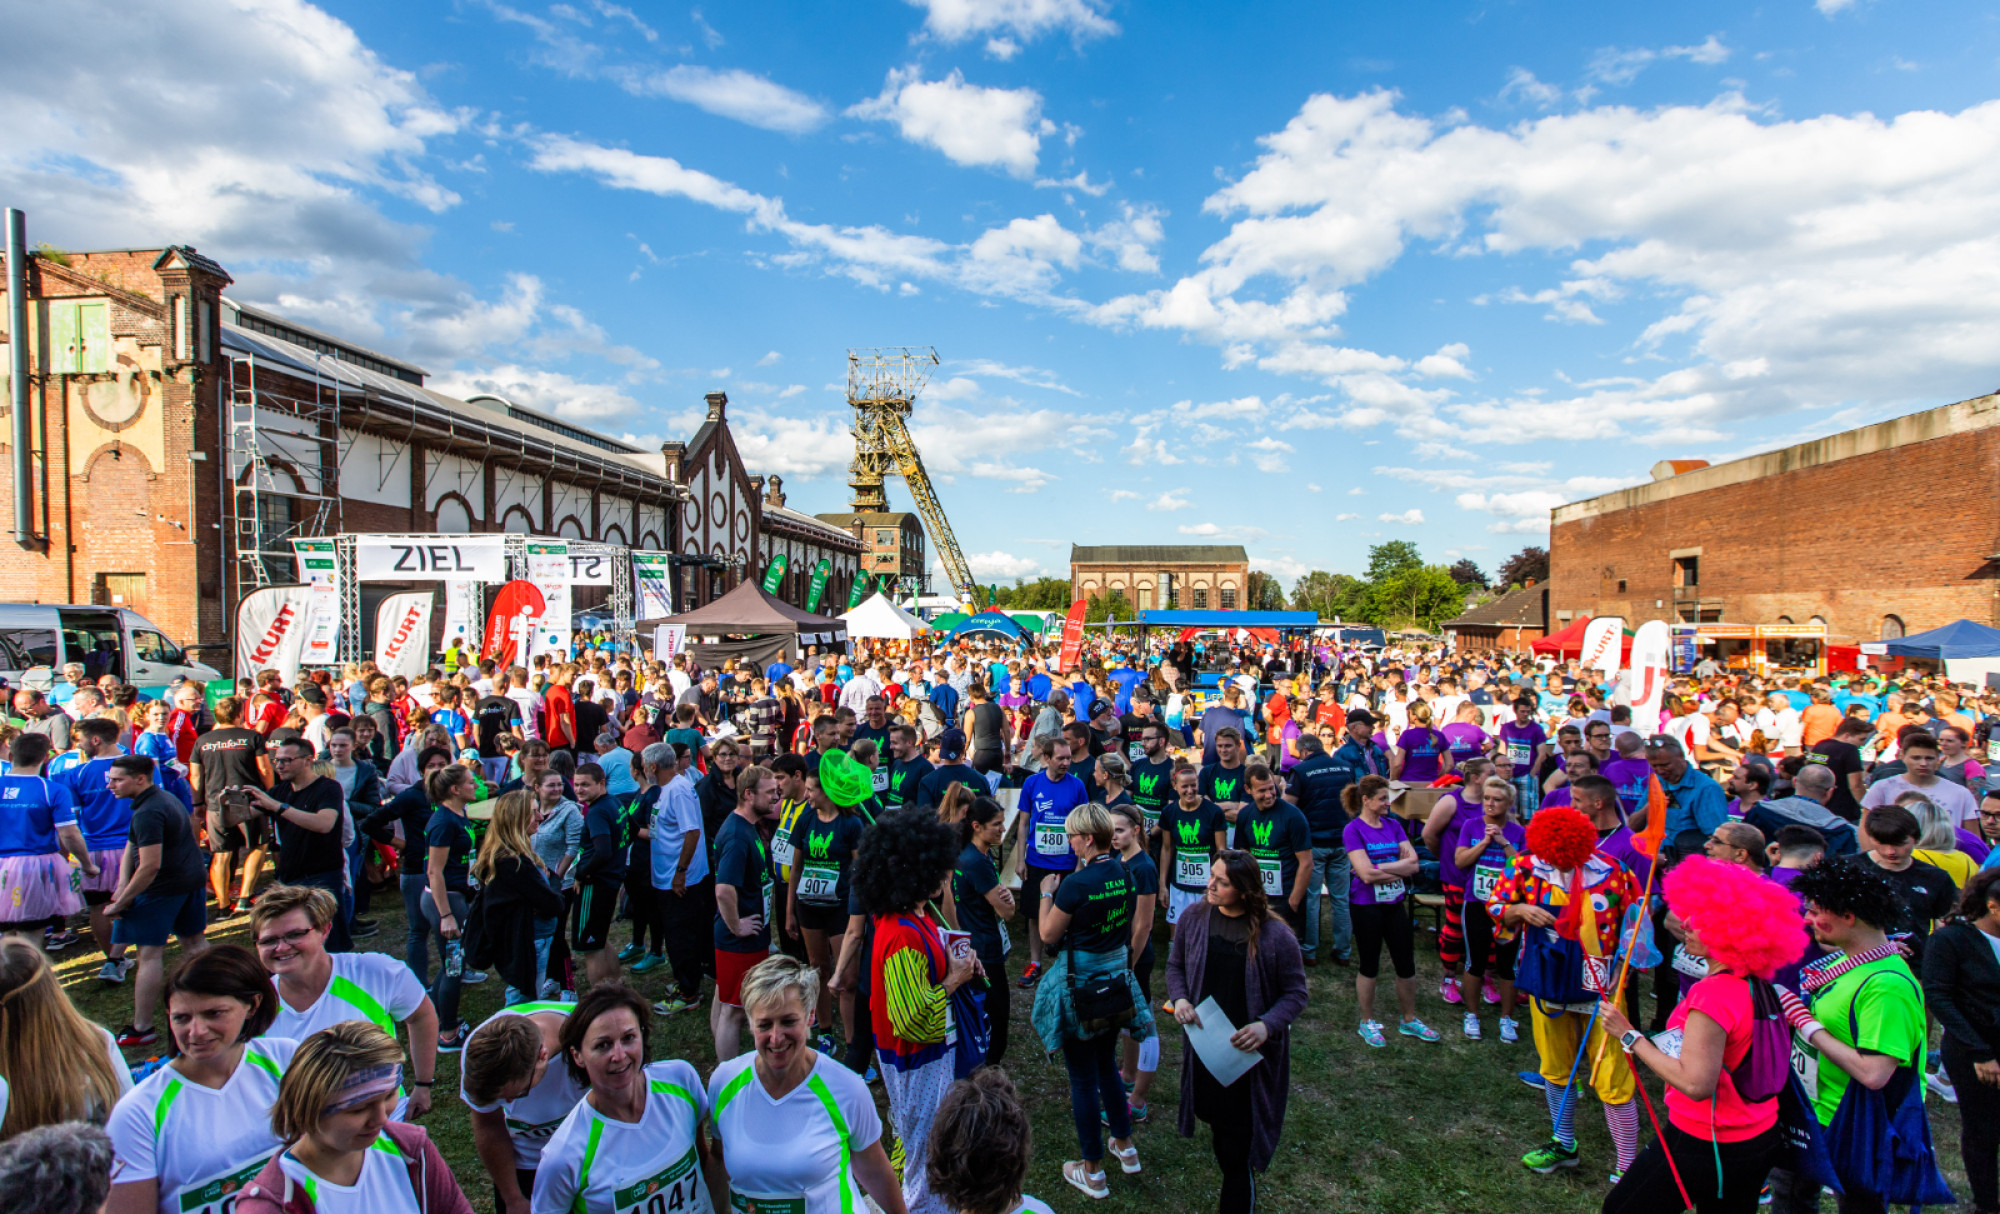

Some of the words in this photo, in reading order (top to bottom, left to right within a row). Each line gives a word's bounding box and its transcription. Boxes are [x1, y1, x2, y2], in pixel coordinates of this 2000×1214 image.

[389, 545, 475, 572] ZIEL
[250, 603, 295, 664] KURT
[384, 606, 421, 659] KURT
[1591, 626, 1615, 663] KURT
[774, 838, 789, 854] 757
[1041, 833, 1064, 846] 480
[1181, 862, 1205, 876] 905
[804, 878, 830, 895] 907
[1104, 879, 1125, 890] TEAM
